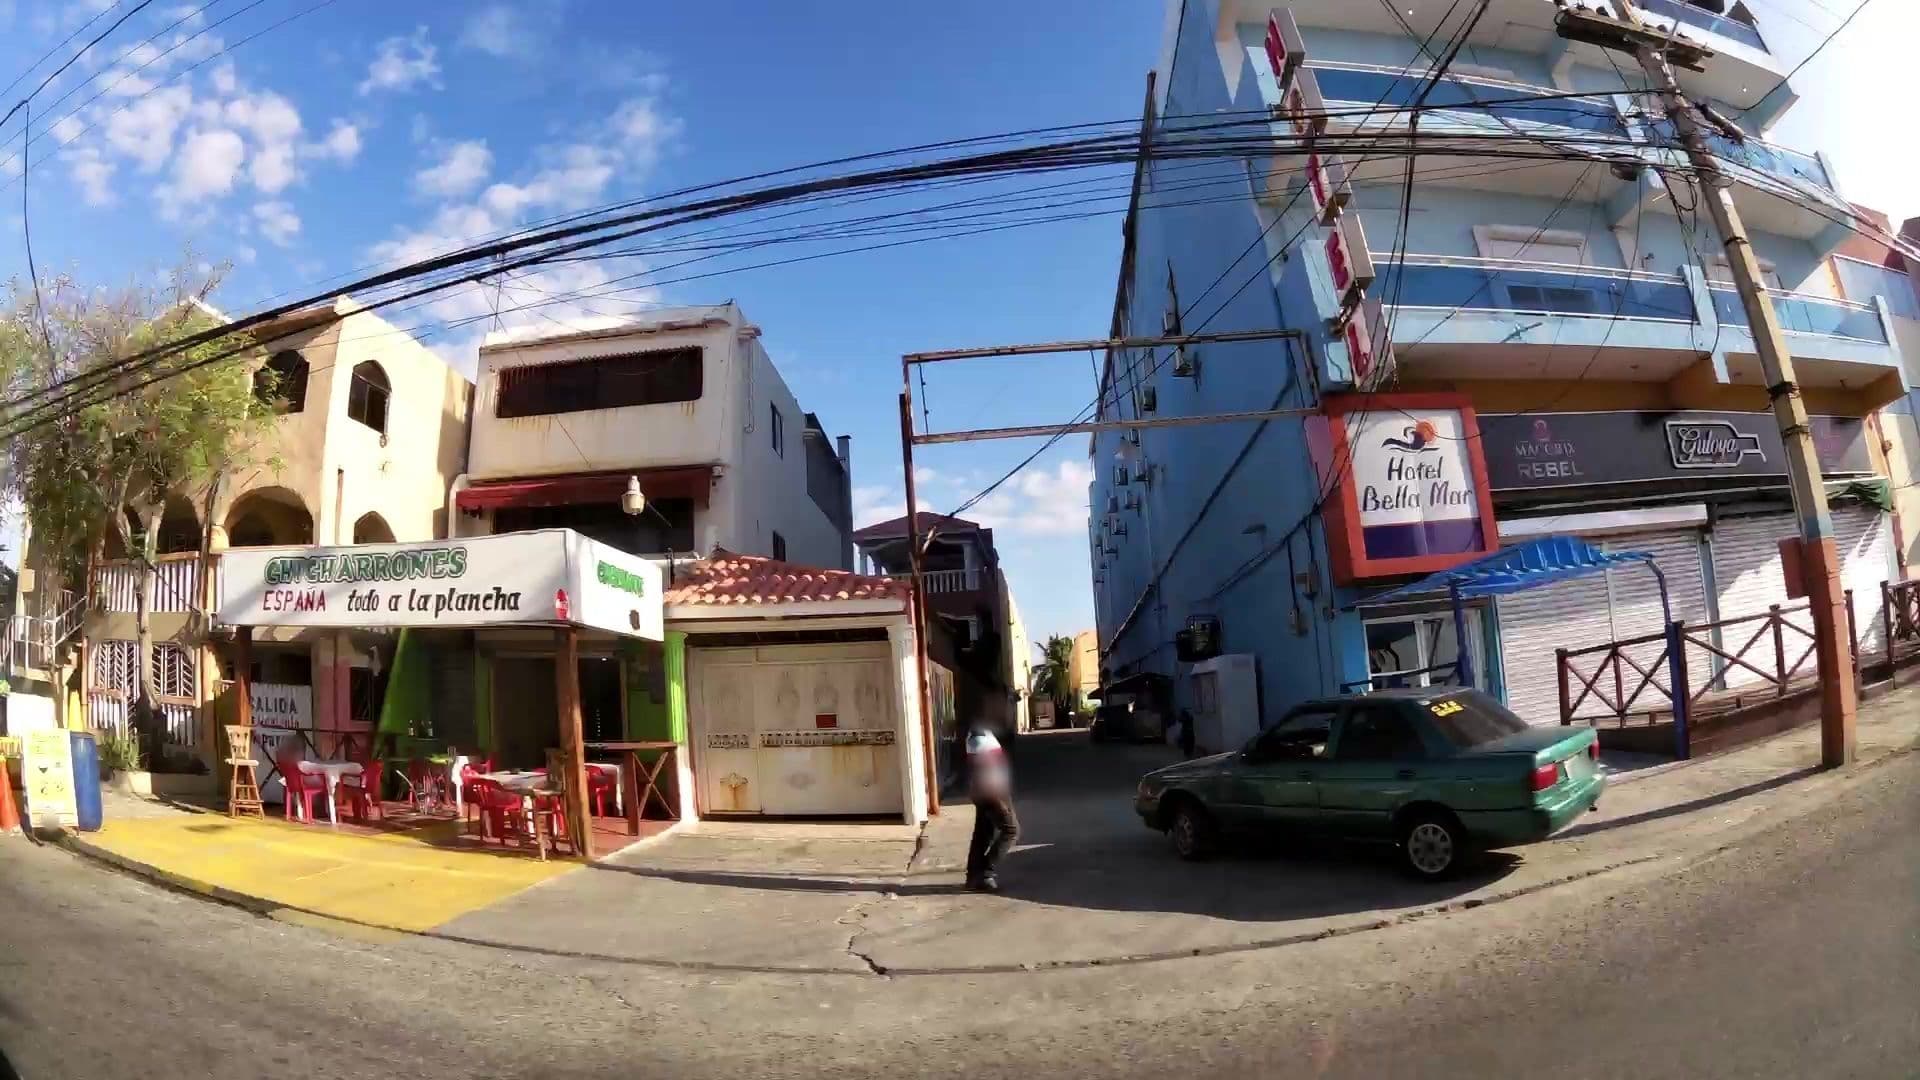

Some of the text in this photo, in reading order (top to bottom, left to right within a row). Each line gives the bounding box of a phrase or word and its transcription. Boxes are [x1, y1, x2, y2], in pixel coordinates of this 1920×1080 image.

[1387, 455, 1443, 481] Hotel
[1518, 461, 1585, 479] REBEL
[1362, 480, 1473, 512] Bella Mar
[263, 547, 468, 585] CHICHARRONES
[262, 586, 521, 619] ESPAÑA todo a la plancha
